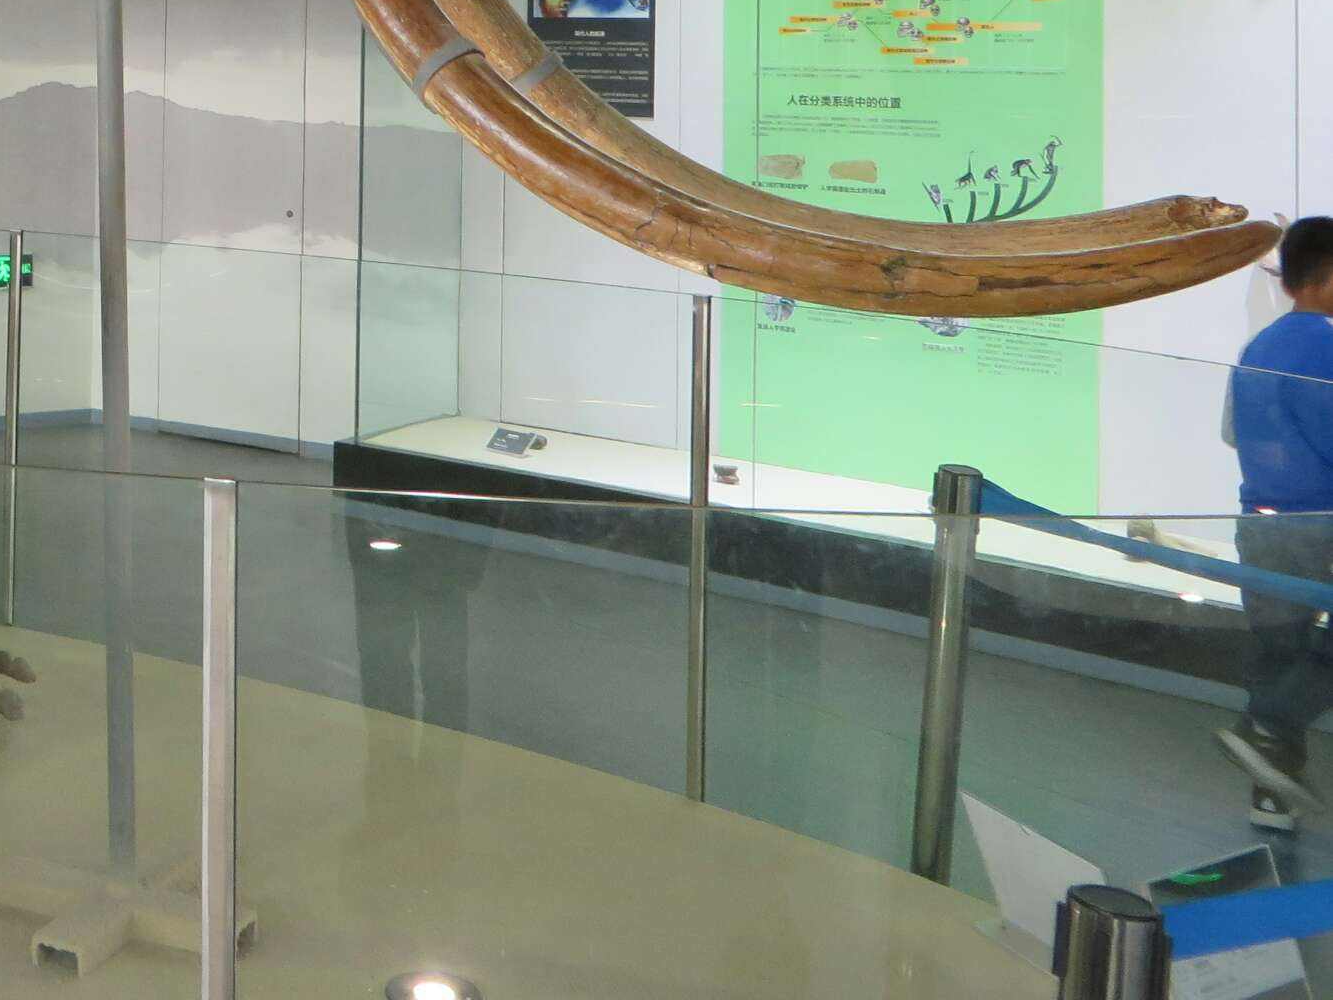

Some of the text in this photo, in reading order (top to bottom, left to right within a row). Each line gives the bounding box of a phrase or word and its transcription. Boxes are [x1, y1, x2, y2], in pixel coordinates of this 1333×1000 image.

[787, 95, 902, 109] 人在分类系统中的位置
